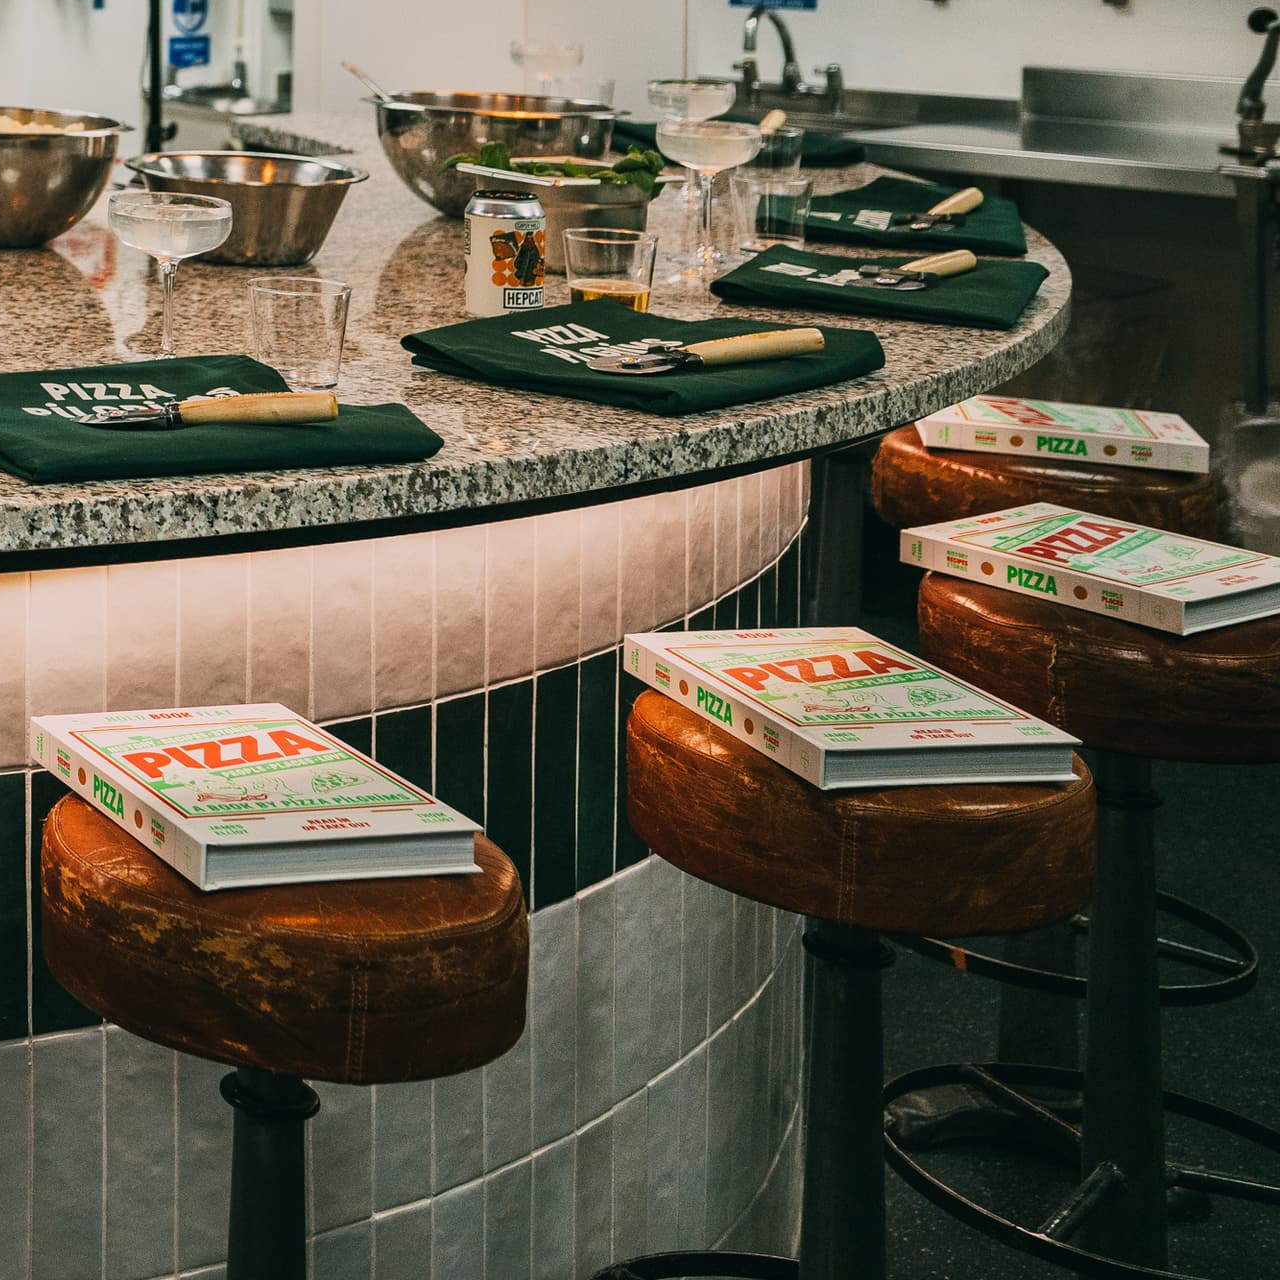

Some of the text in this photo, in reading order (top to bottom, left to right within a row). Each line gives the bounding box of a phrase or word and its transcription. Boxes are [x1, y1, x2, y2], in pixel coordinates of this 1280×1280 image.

[40, 383, 177, 401] PIZZA
[1036, 435, 1088, 456] PIZZA
[1016, 521, 1138, 563] PIZZA
[946, 556, 969, 566] RECIPES
[1006, 564, 1058, 597] PIZZA
[1101, 595, 1124, 607] PLACES
[736, 631, 778, 639] BOOK
[722, 650, 919, 691] PIZZA
[149, 711, 193, 720] BOOK
[696, 686, 733, 727] PIZZA
[816, 713, 862, 721] BOOK
[763, 733, 779, 747] PLACES
[121, 729, 332, 778] PIZZA
[221, 752, 351, 779] PEOPLE PLACES LOVE
[93, 774, 125, 820] PIZZA
[191, 805, 205, 813] A
[208, 803, 253, 813] BOOK
[255, 800, 276, 809] BY
